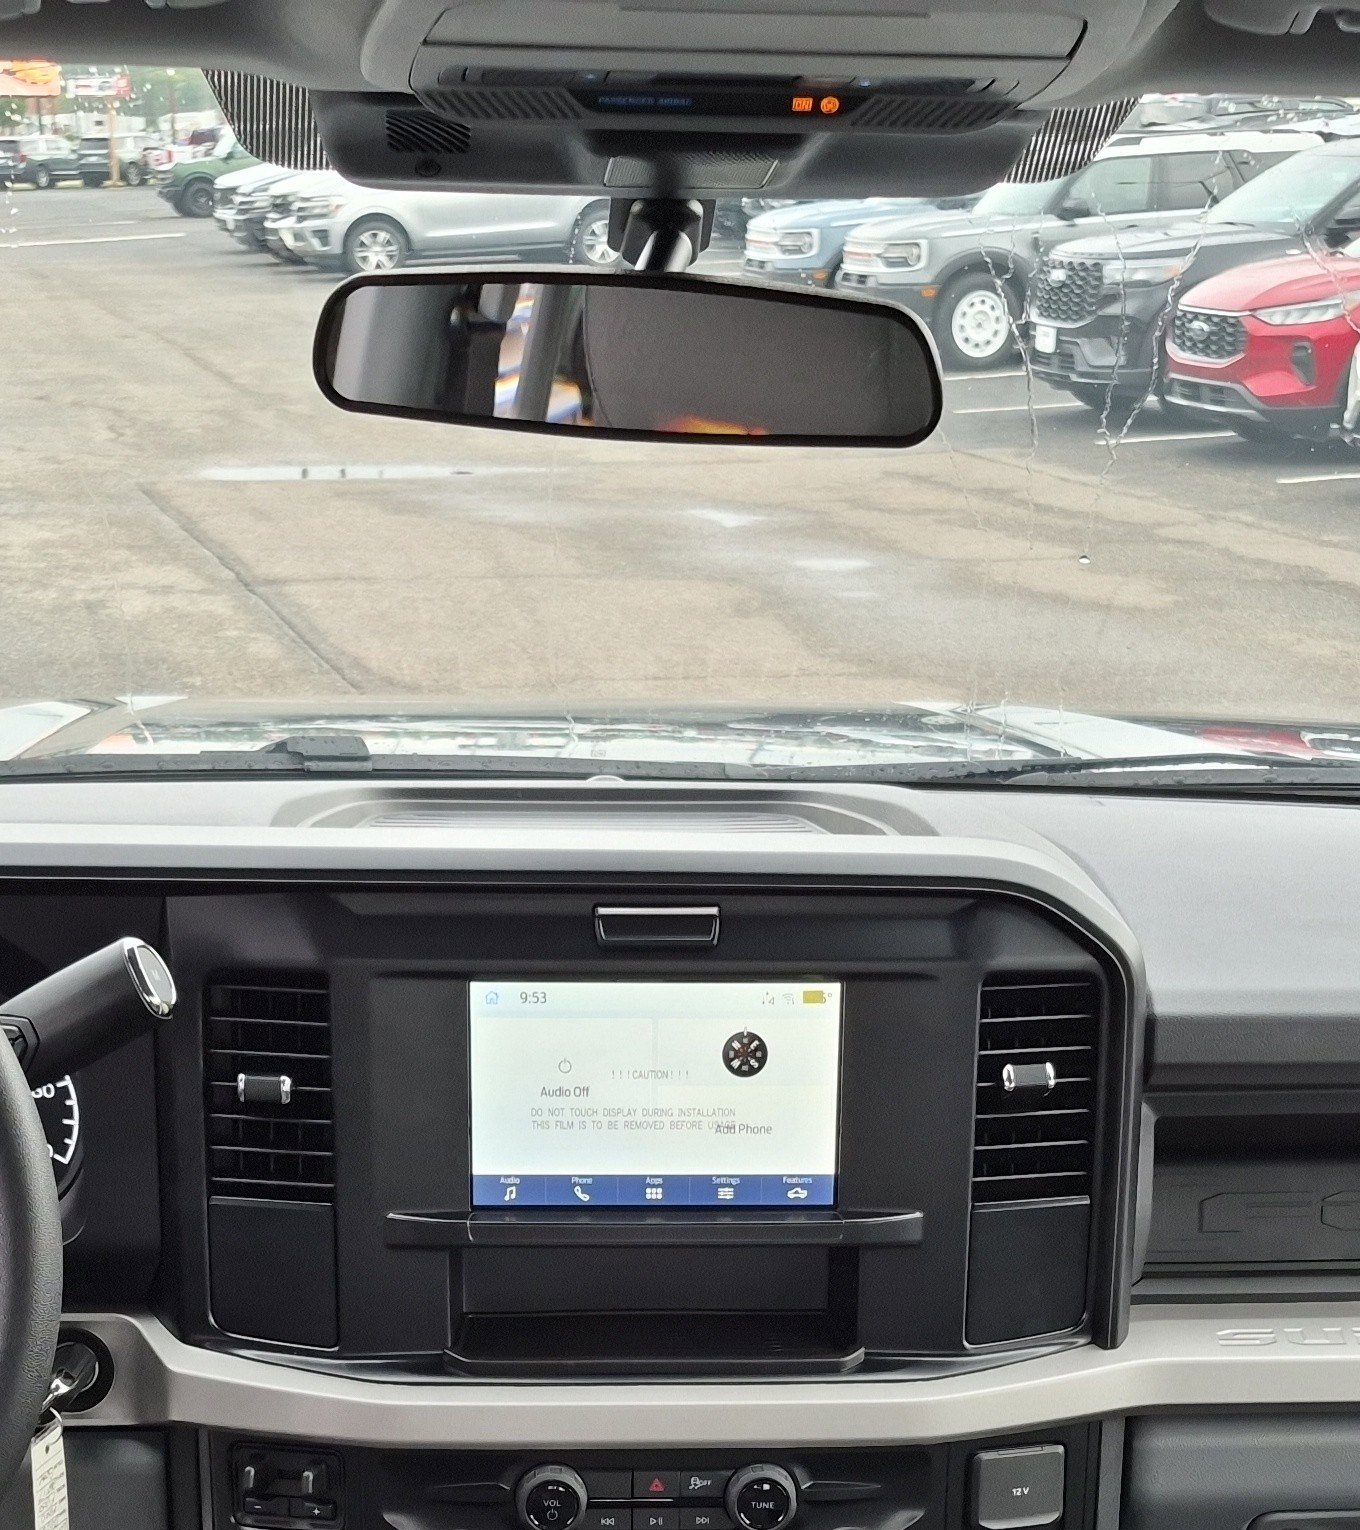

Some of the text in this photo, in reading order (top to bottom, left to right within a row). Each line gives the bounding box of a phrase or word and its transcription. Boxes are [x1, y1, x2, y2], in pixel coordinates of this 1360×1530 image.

[520, 991, 547, 1004] 9:53
[540, 1086, 590, 1098] Audio Off
[531, 1108, 736, 1117] DO NOT TOUCH DISPLAY DURING INSTALLATION
[532, 1120, 550, 1130] THIS
[555, 1120, 574, 1130] FILM
[579, 1120, 587, 1130] IS
[592, 1120, 602, 1130] TO
[608, 1120, 618, 1130] BE
[624, 1120, 664, 1130] REMOVED
[670, 1120, 703, 1130] BEFORE
[715, 1123, 773, 1134] Add Phone
[500, 1176, 520, 1184] Audio
[571, 1176, 592, 1185] Phone
[645, 1177, 663, 1185] Apps
[712, 1176, 740, 1185] Settings
[783, 1176, 812, 1184] Features
[1012, 1487, 1023, 1496] 12
